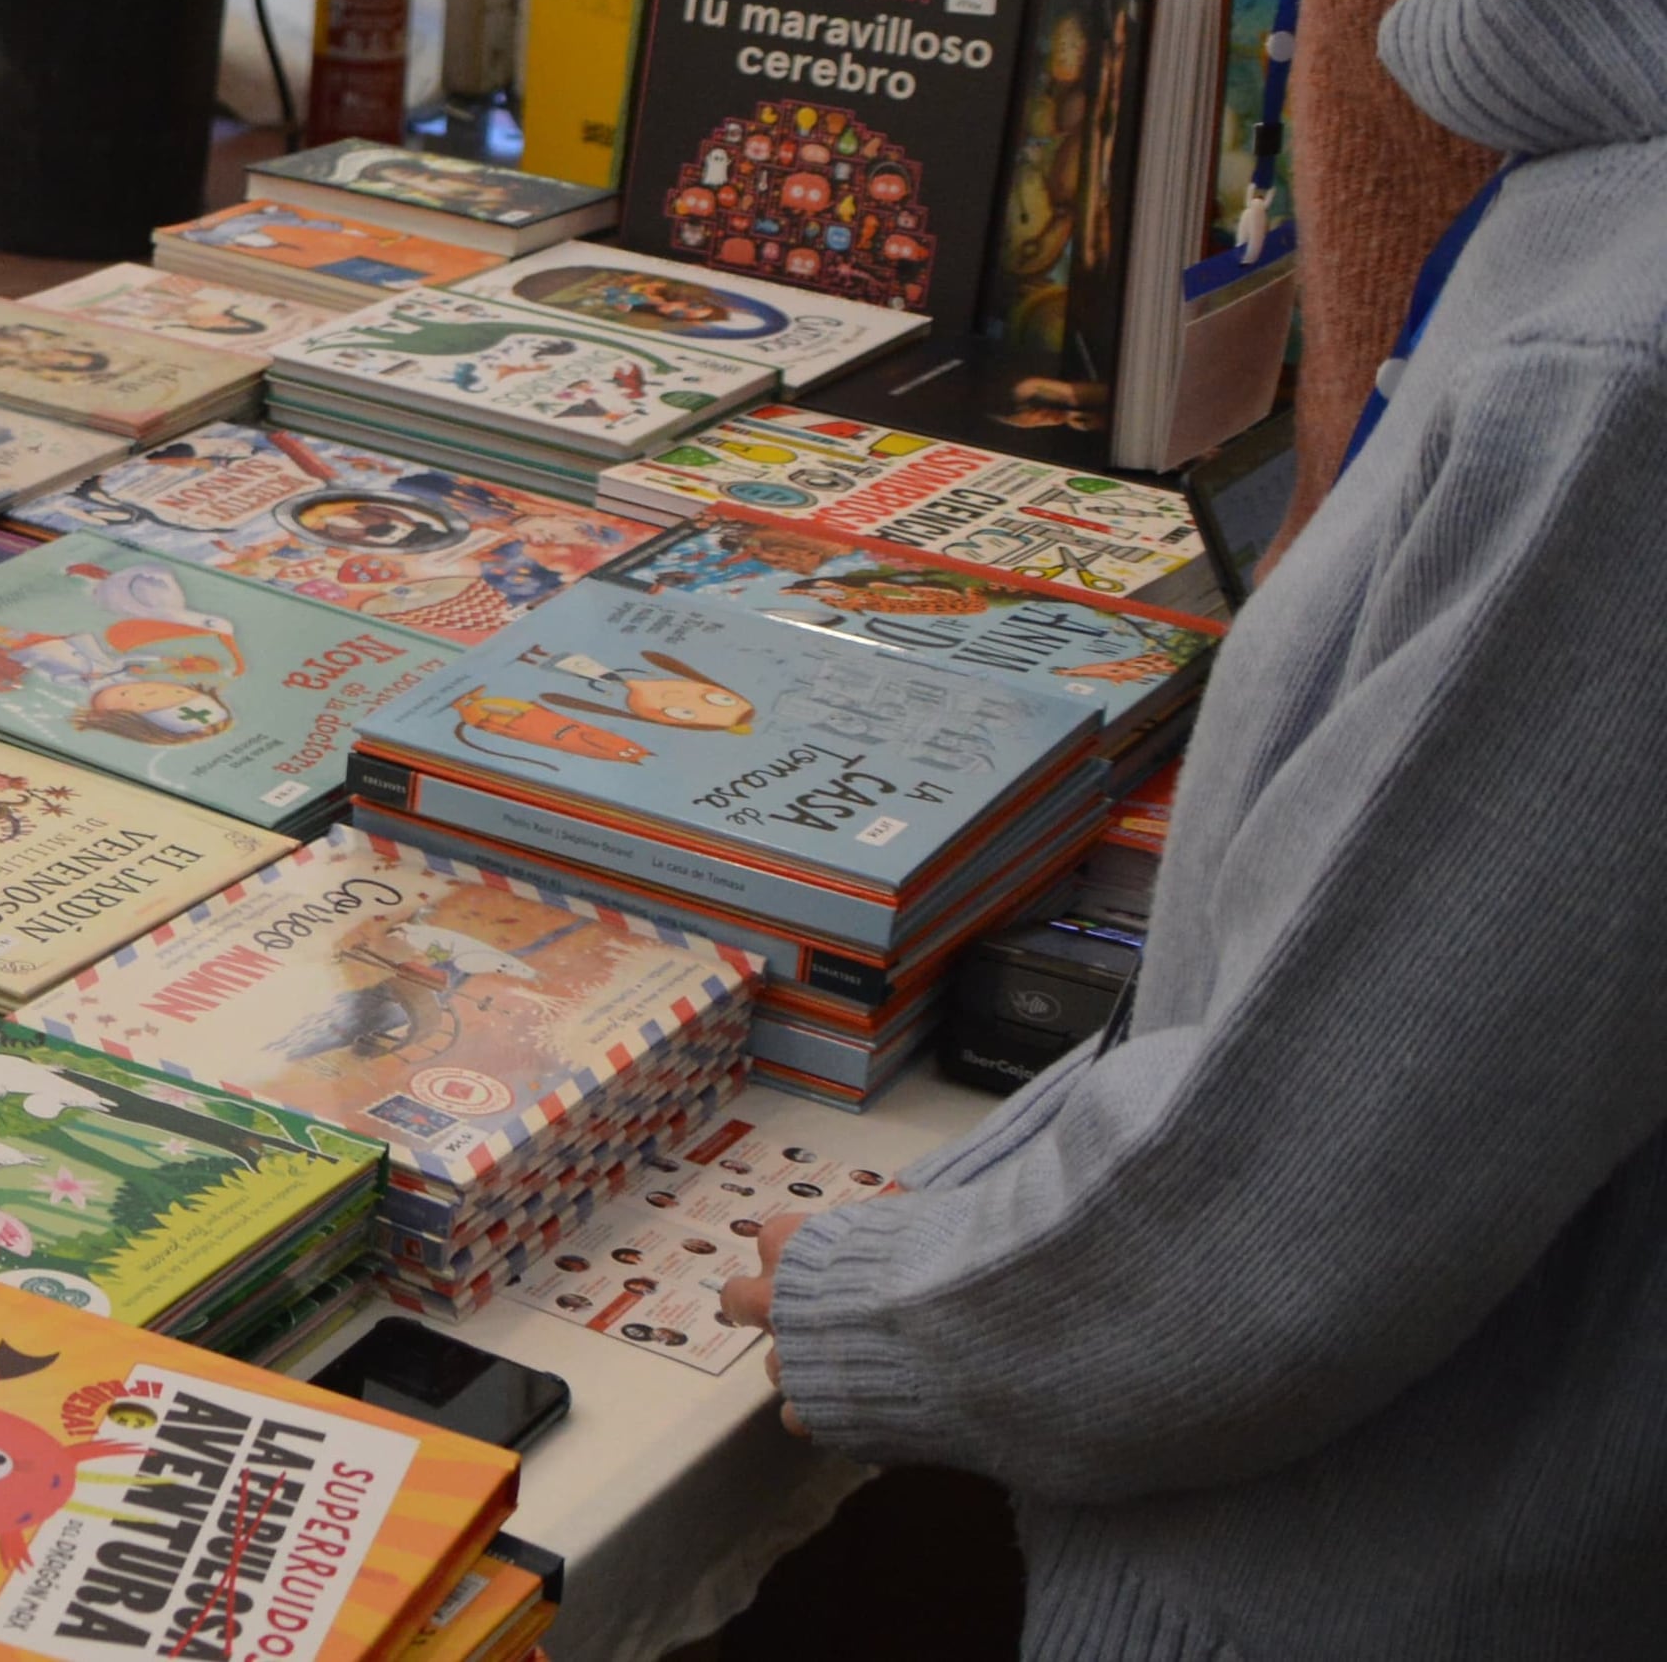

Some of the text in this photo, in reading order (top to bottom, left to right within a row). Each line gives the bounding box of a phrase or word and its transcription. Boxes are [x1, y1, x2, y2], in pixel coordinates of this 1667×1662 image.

[740, 1, 994, 70] maravilloso
[736, 45, 917, 100] cerebro
[805, 446, 997, 533] ASOMBROSA
[859, 487, 1008, 548] CIENCIA
[279, 633, 409, 695] Nora
[272, 709, 342, 778] doctora
[691, 742, 866, 808] Tomasa
[79, 817, 109, 839] DE
[724, 804, 763, 827] de
[767, 769, 897, 834] CASA
[136, 842, 201, 880] EL
[705, 867, 746, 893] Tomasa
[13, 851, 142, 945] JARDÍN
[251, 876, 405, 957] Correo
[138, 944, 282, 1024] MUMIN
[251, 1417, 328, 1476] LA
[53, 1390, 252, 1650] AVENTURA
